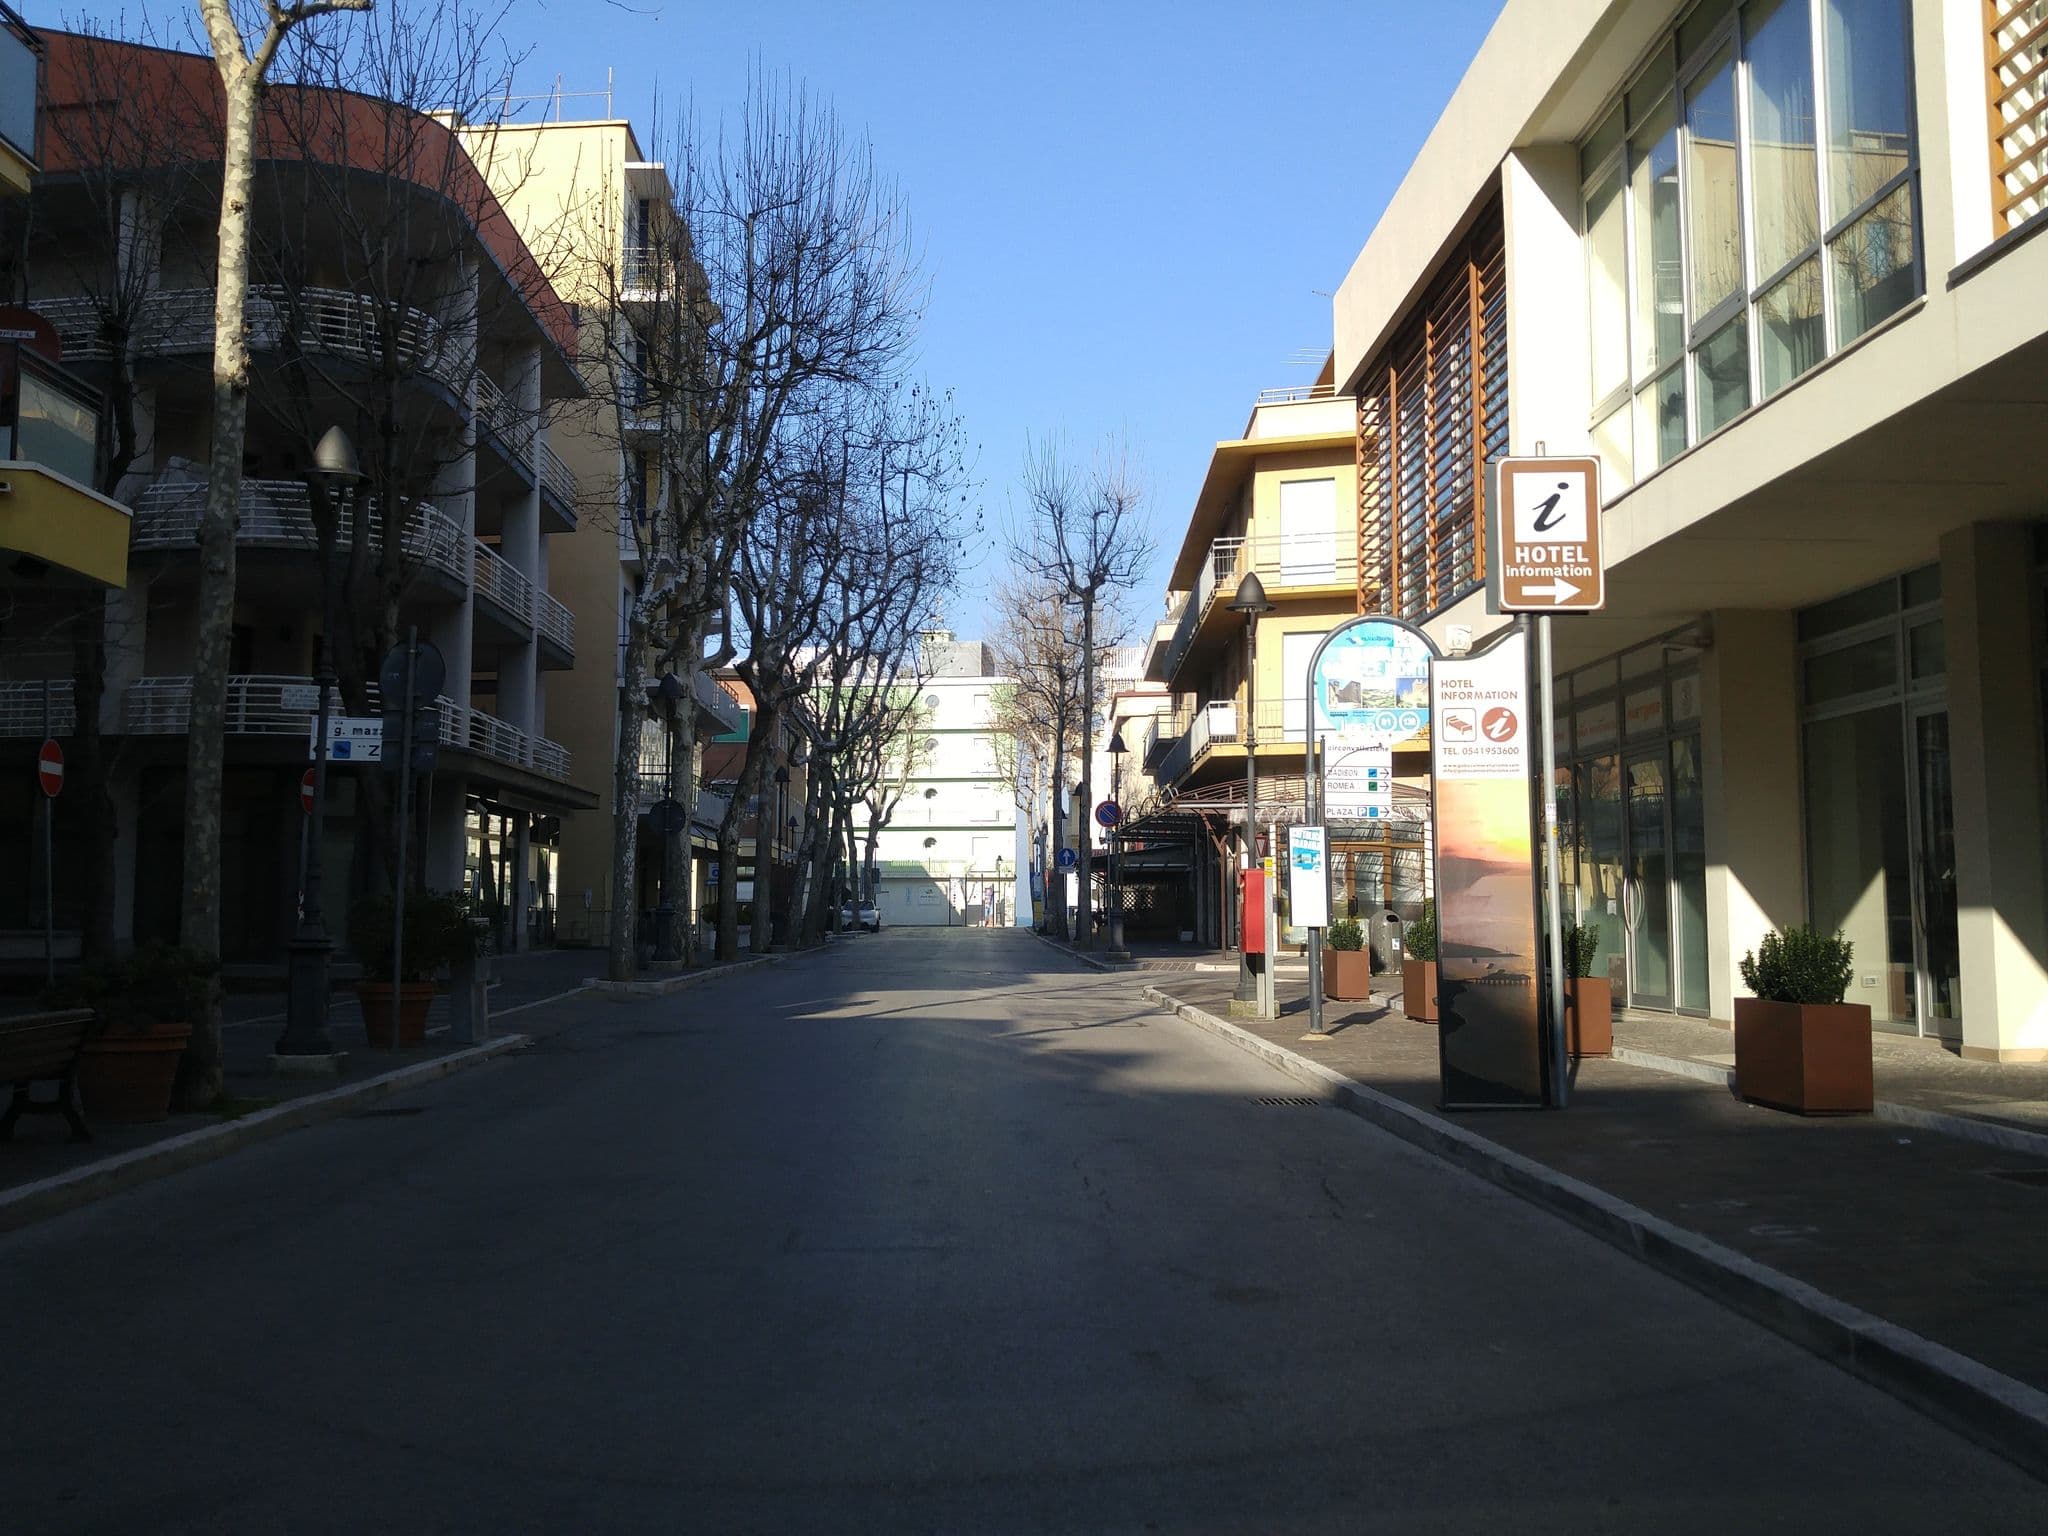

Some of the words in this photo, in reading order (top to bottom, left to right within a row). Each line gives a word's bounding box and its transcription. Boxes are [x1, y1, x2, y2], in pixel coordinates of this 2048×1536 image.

[1515, 545, 1589, 563] HOTEL
[1506, 564, 1592, 577] information
[1440, 679, 1474, 689] HOTEL
[1441, 690, 1518, 700] INFORMATION
[334, 727, 345, 737] g.
[1442, 747, 1460, 755] TEL.
[1462, 747, 1519, 755] 0541953600
[1326, 807, 1353, 816] PLAZA
